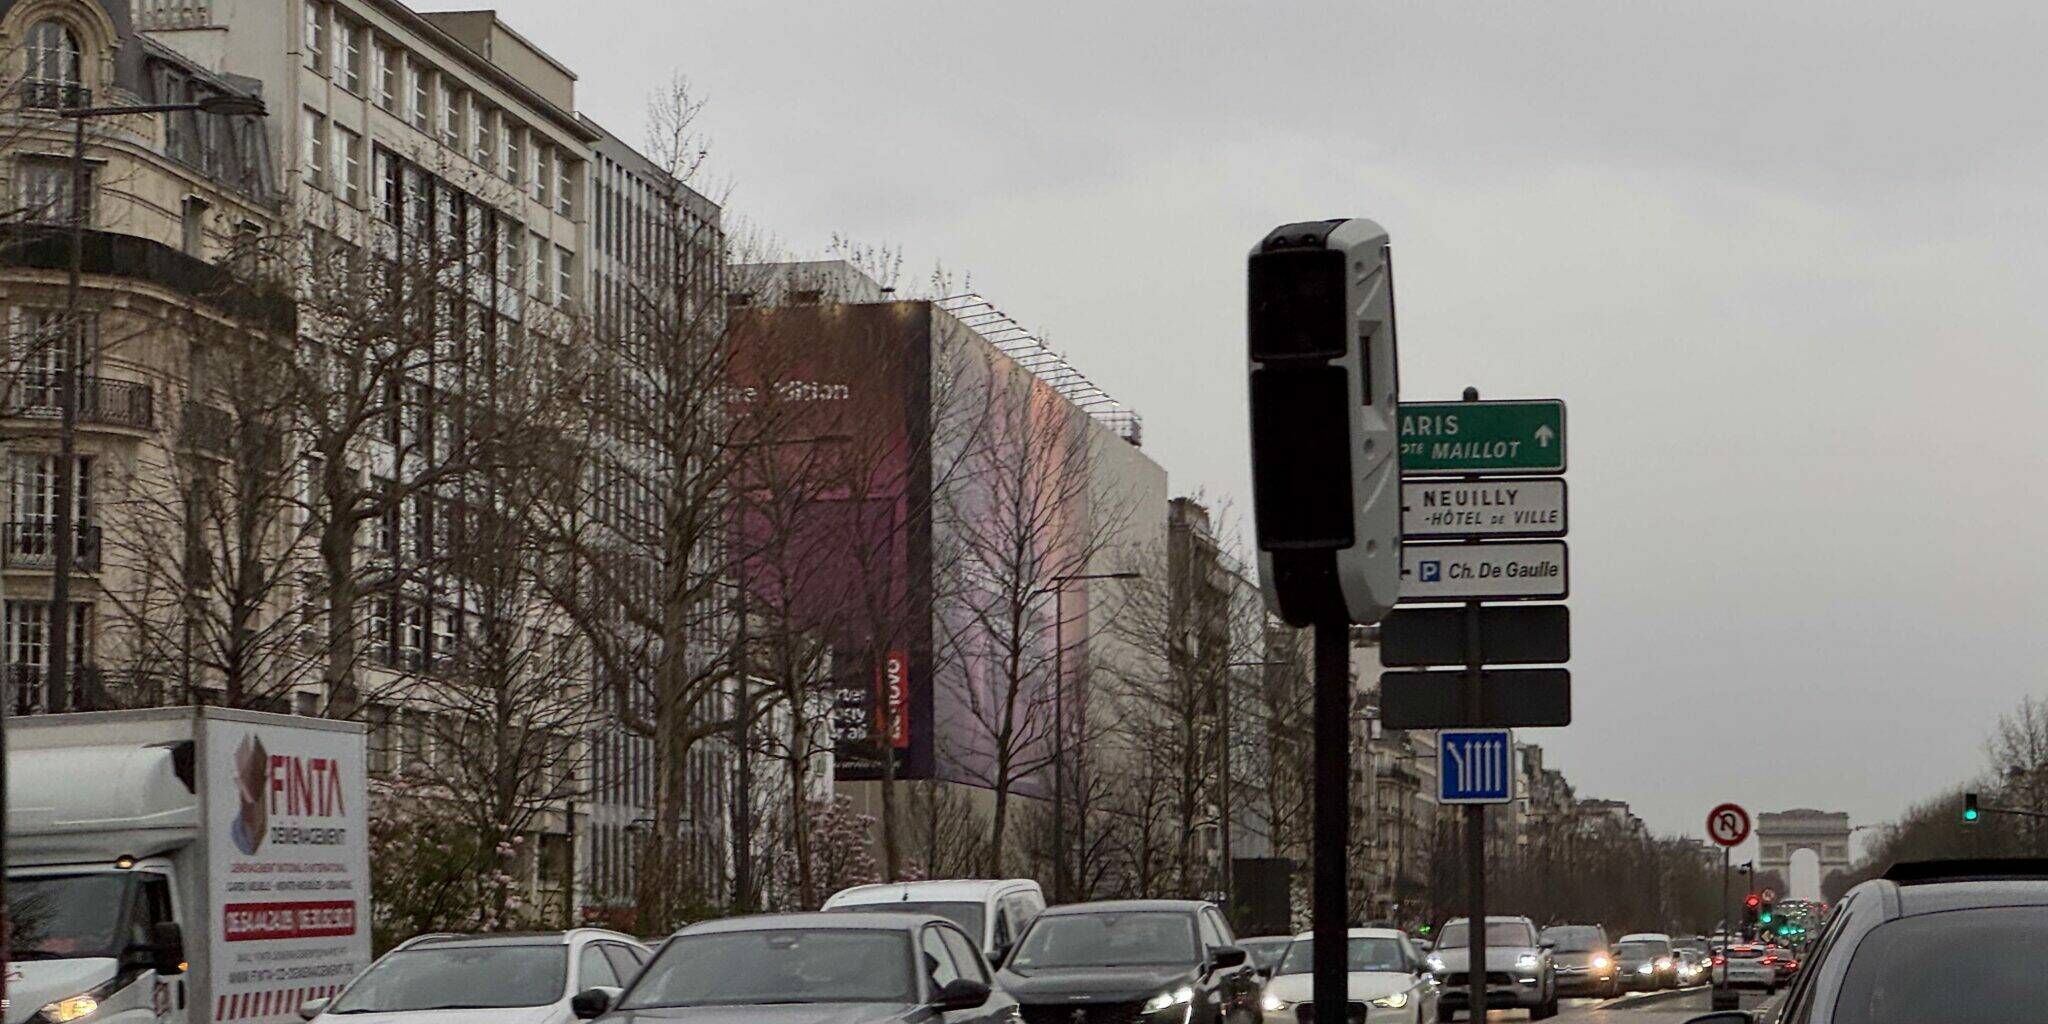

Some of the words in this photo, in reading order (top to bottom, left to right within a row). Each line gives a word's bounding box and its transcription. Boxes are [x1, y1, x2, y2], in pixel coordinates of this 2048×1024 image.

[1401, 415, 1459, 436] ARIS
[1431, 441, 1521, 459] MAILLOT
[1423, 490, 1519, 507] NEUILLY
[1514, 510, 1558, 524] VILLE
[1422, 564, 1437, 581] P
[1449, 563, 1475, 579] Ch.
[1479, 562, 1501, 578] De
[1506, 561, 1559, 578] Gaulle
[270, 755, 345, 817] FINTA
